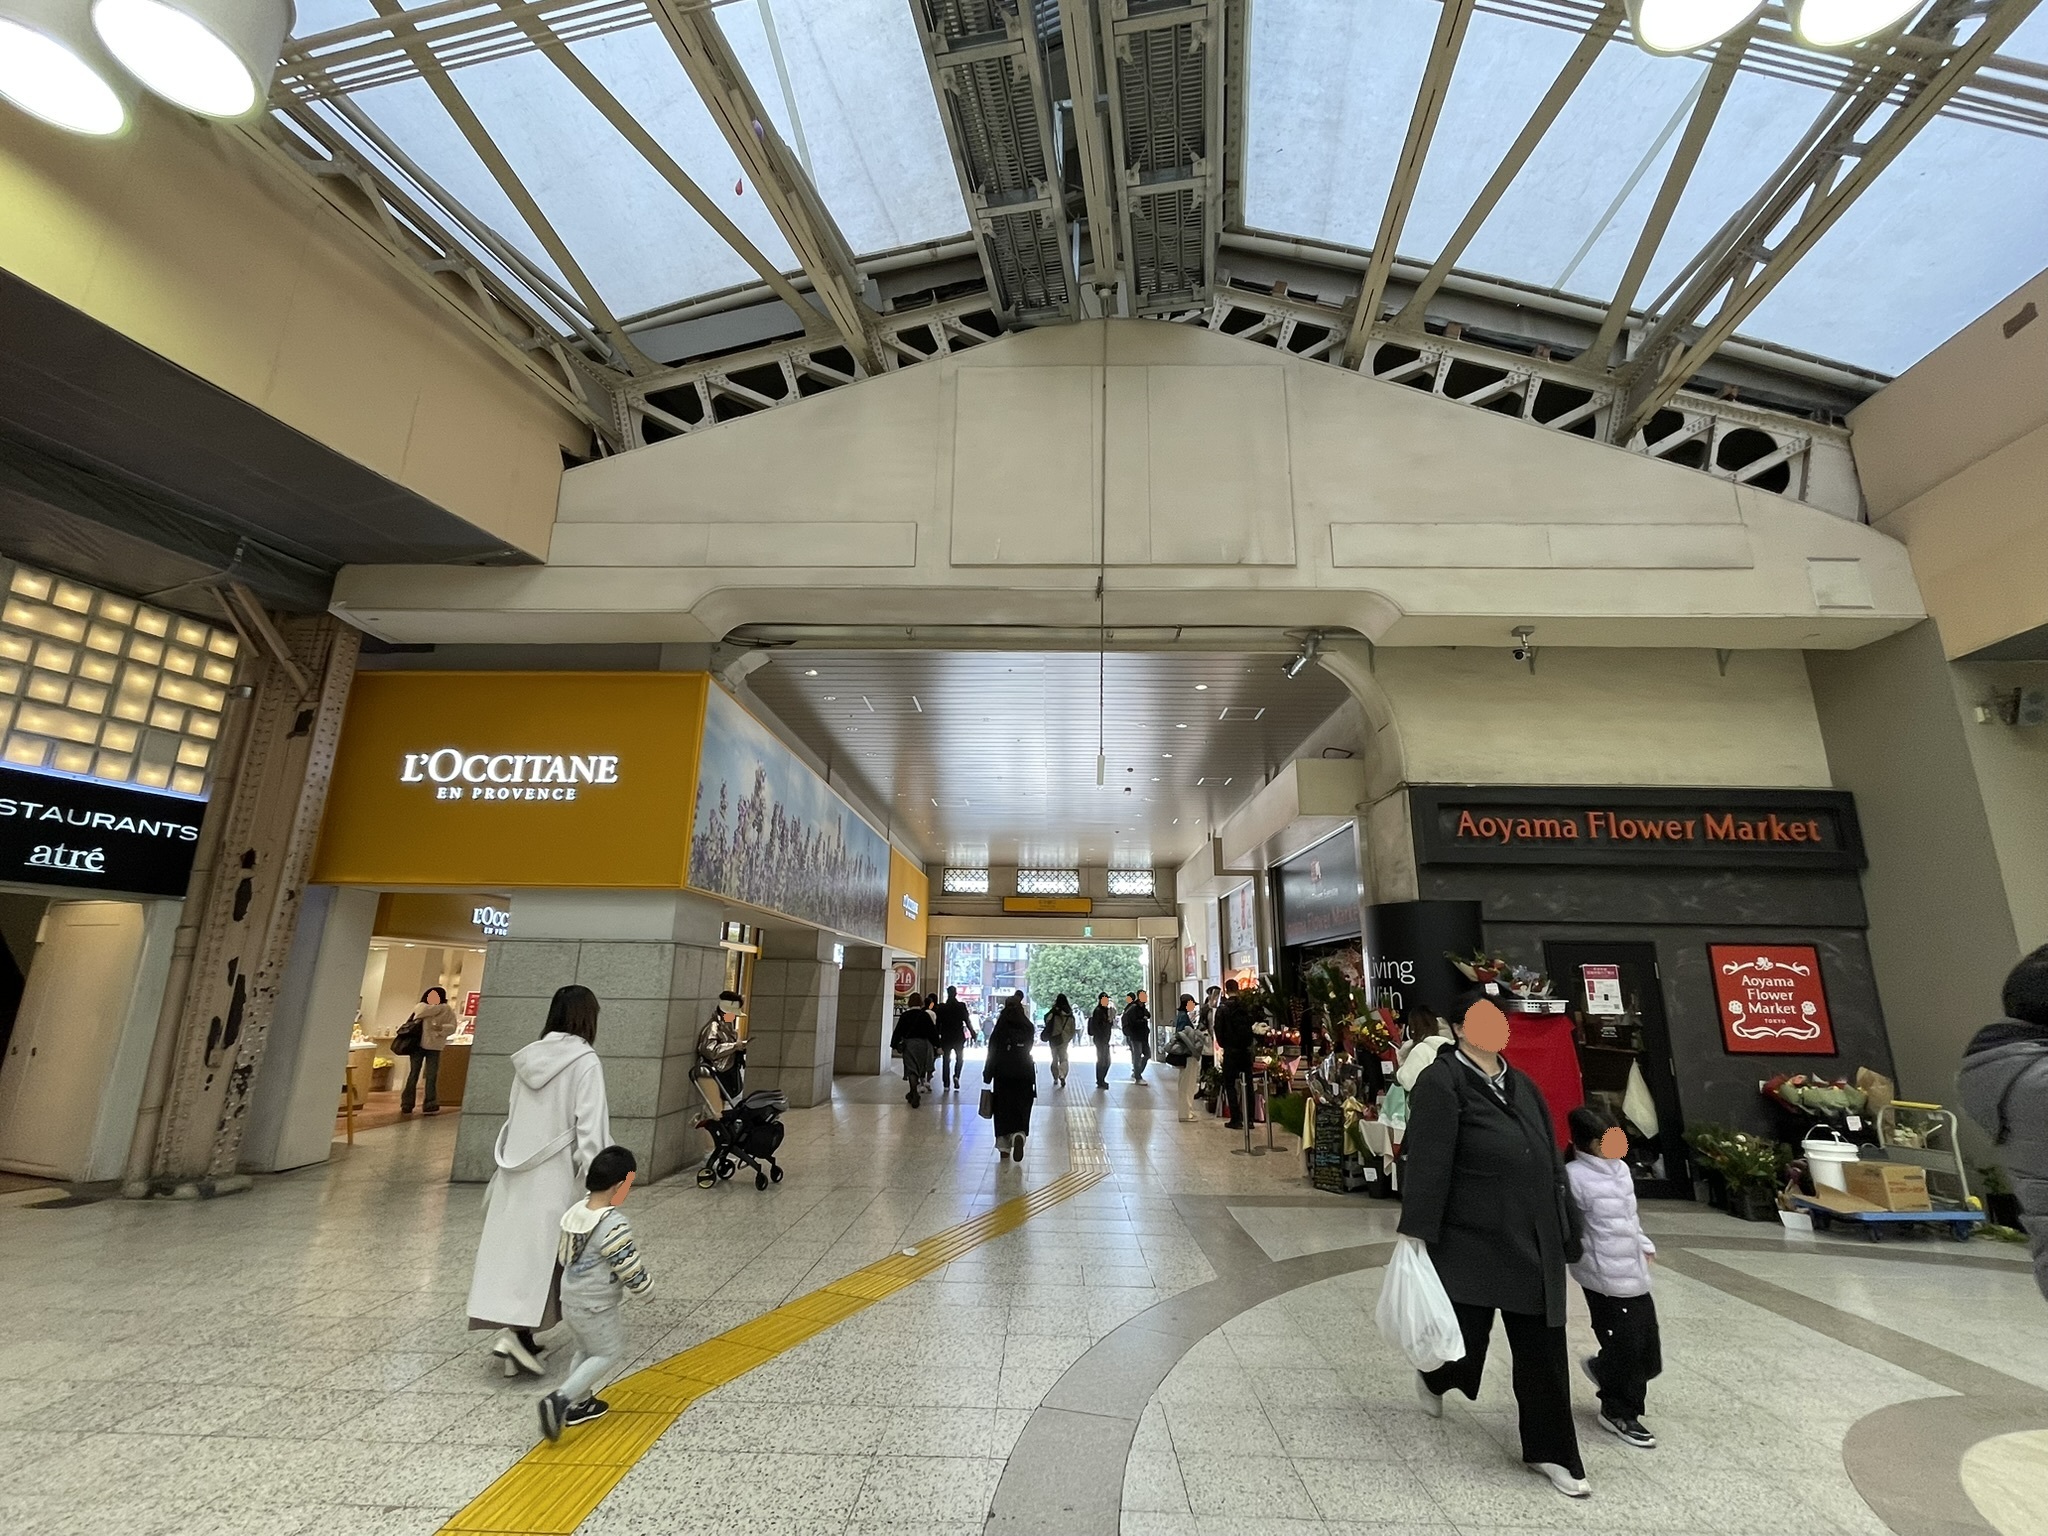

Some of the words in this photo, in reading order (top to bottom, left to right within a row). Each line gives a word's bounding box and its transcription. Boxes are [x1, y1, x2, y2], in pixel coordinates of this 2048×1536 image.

[400, 749, 619, 784] L'OCCITANE
[436, 787, 463, 800] EN
[472, 787, 577, 801] PROVENCE
[1457, 810, 1579, 845] Aoyama
[1585, 811, 1695, 842] Flower
[1705, 813, 1823, 843] Market
[29, 842, 105, 872] atré
[1741, 974, 1795, 988] Aoyama
[1747, 988, 1794, 1001] Flower
[1748, 1001, 1797, 1015] Market
